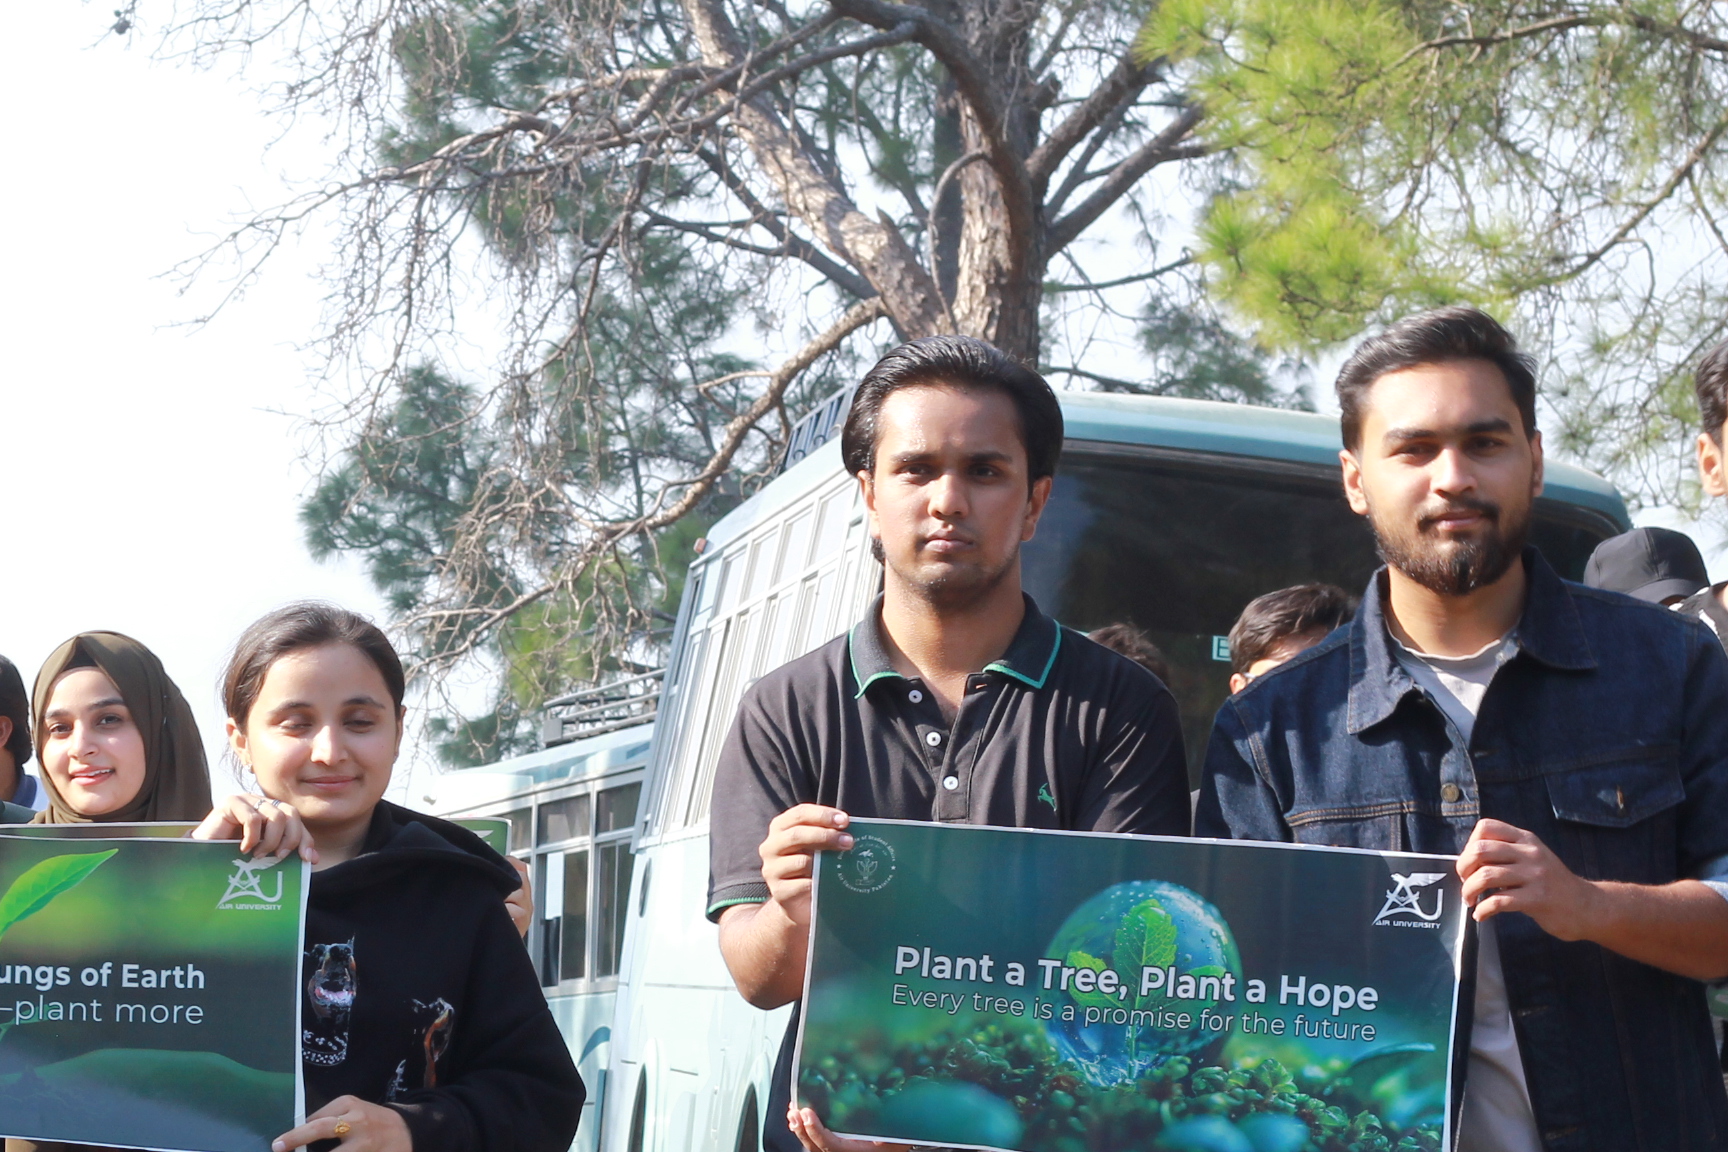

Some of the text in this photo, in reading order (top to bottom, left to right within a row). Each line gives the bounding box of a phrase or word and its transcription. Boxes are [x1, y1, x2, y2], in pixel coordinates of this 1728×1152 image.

[235, 903, 283, 911] UNIVERSITY
[1393, 920, 1441, 930] UNIVERSITY
[80, 961, 113, 987] of
[121, 963, 206, 989] Earth
[894, 945, 1379, 1016] Plant a Tree, Plant a Hope
[115, 1002, 204, 1024] more
[892, 984, 1377, 1041] Every tree is a promise for the future
